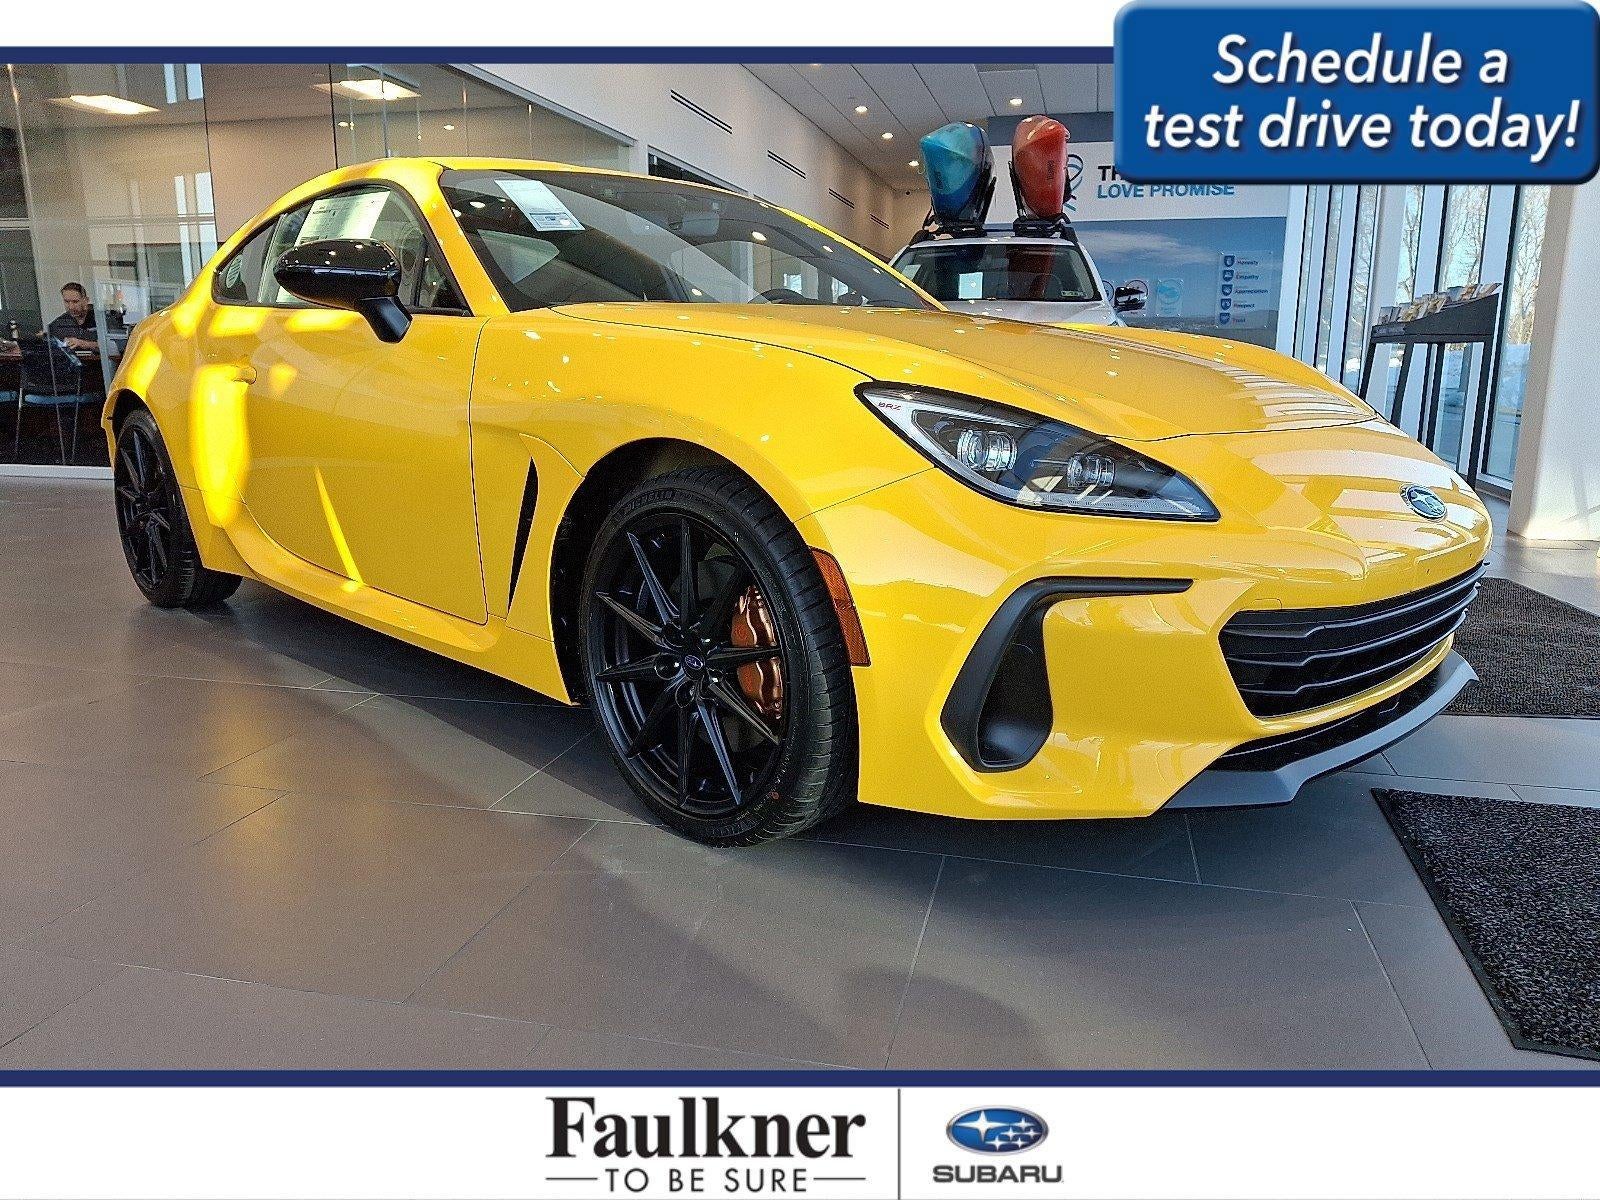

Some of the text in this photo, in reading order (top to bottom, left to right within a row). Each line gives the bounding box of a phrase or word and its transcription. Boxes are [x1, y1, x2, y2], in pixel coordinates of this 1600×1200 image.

[1097, 183, 1235, 199] LOVE PROMISE
[878, 401, 901, 411] BRZ
